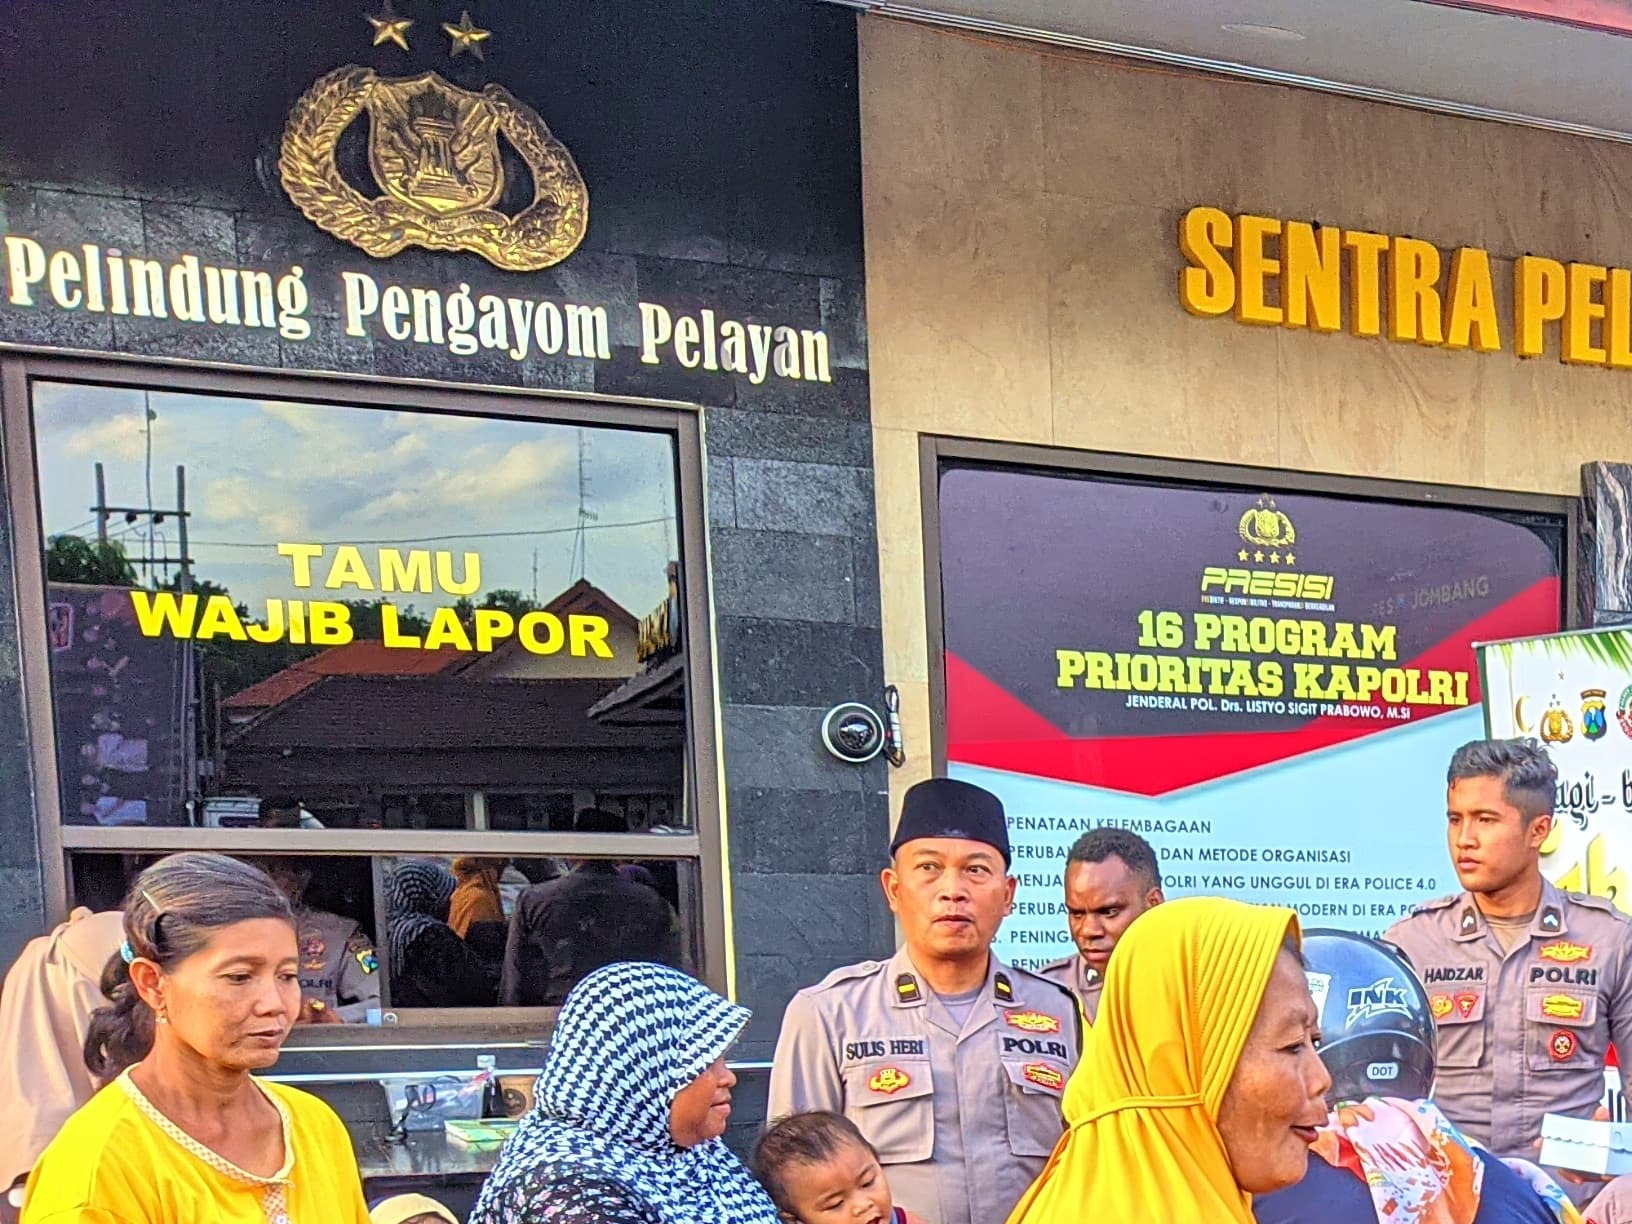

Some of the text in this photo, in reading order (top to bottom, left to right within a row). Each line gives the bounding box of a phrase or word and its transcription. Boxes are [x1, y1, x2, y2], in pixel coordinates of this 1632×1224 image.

[1179, 206, 1500, 350] SENTRA
[5, 236, 832, 384] Pelindung Pengayom Pelayan
[278, 543, 482, 594] TAMU
[1201, 567, 1334, 600] PRESISI
[130, 591, 613, 659] WAJIB LAPOR
[1138, 610, 1396, 660] 16 PROGRAM
[1056, 650, 1469, 706] PRIORITAS KAPOLRI
[1125, 695, 1187, 710] JENDERAL
[1190, 698, 1218, 711] POL.
[1221, 699, 1243, 712] Drs.
[1246, 700, 1285, 714] LISTYO
[1288, 703, 1318, 716] SIGIT
[1320, 705, 1384, 719] PRABOWO,
[1007, 816, 1091, 831] PENATAAN
[1009, 845, 1351, 863] PERUBA DAN METODE ORGANISASI
[1159, 876, 1196, 889] OLRI
[1202, 876, 1245, 889] YANG
[1251, 876, 1311, 890] UNGGUL
[1316, 877, 1330, 889] DI
[1335, 877, 1360, 890] ERA
[1365, 878, 1412, 891] POLICE
[1416, 878, 1436, 890] 4.0
[1010, 903, 1067, 916] PERUBA
[1352, 904, 1365, 917] DI
[1371, 904, 1395, 917] ERA
[1010, 931, 1074, 943] PENING
[1424, 967, 1598, 986] HAIDZAR POLRI
[1348, 977, 1409, 1010] INK
[846, 1036, 1067, 1060] SULIS HERI POLRI
[1371, 1066, 1394, 1076] DOT
